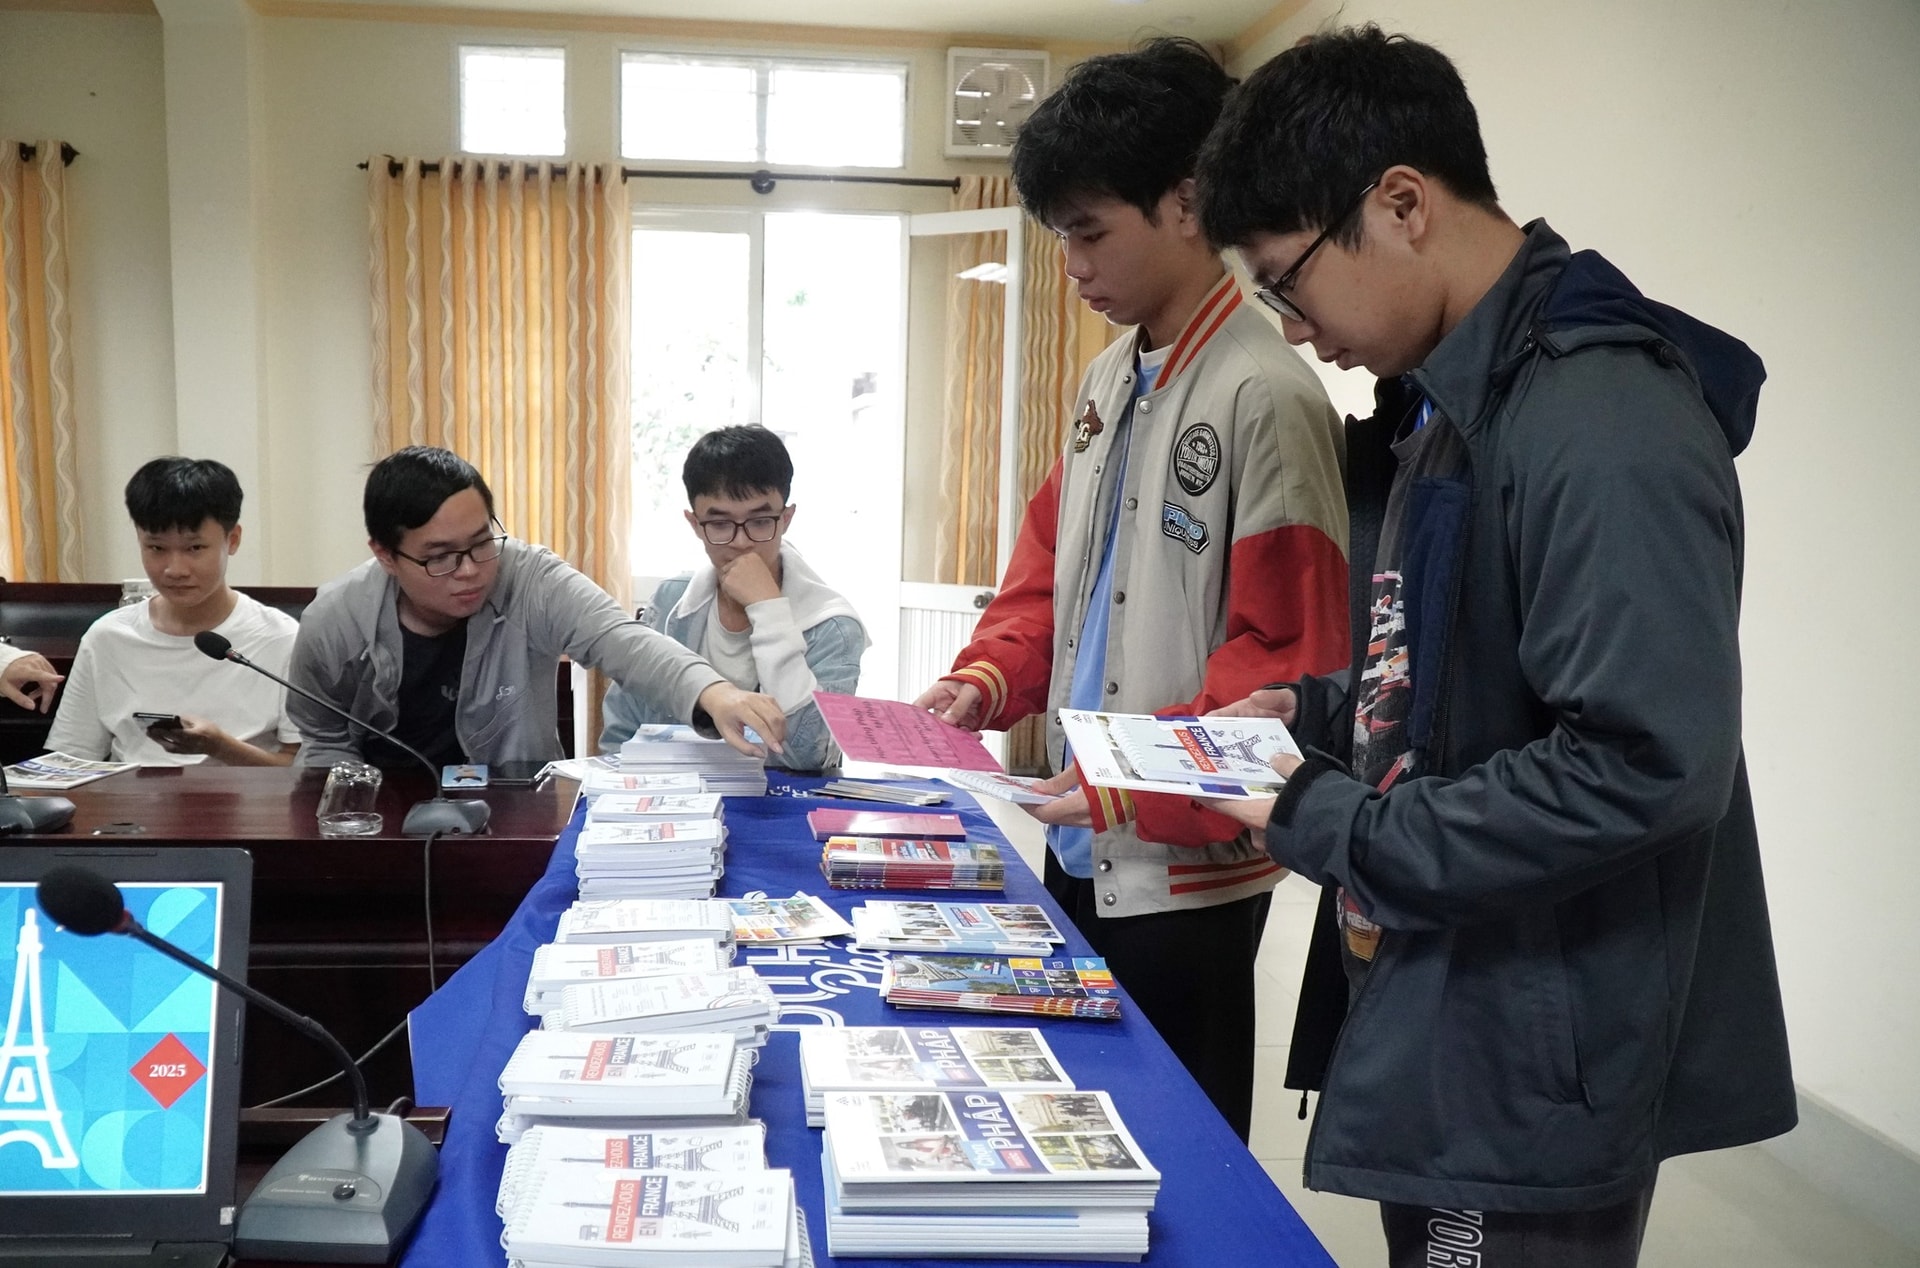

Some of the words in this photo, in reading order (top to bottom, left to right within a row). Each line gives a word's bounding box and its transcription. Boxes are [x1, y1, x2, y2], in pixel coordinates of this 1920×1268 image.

[1190, 727, 1219, 756] FRANCE
[586, 1041, 610, 1080] RENDEZ-VOUS
[610, 1037, 632, 1064] FRANCE
[916, 1030, 967, 1070] PHÁP
[148, 1063, 187, 1078] 2025
[962, 1094, 1025, 1149] PHÁP
[632, 1135, 649, 1169] FRANCE
[611, 1182, 636, 1241] RENDEZ-VOUS
[641, 1176, 664, 1218] FRANCE
[638, 1219, 658, 1237] EN
